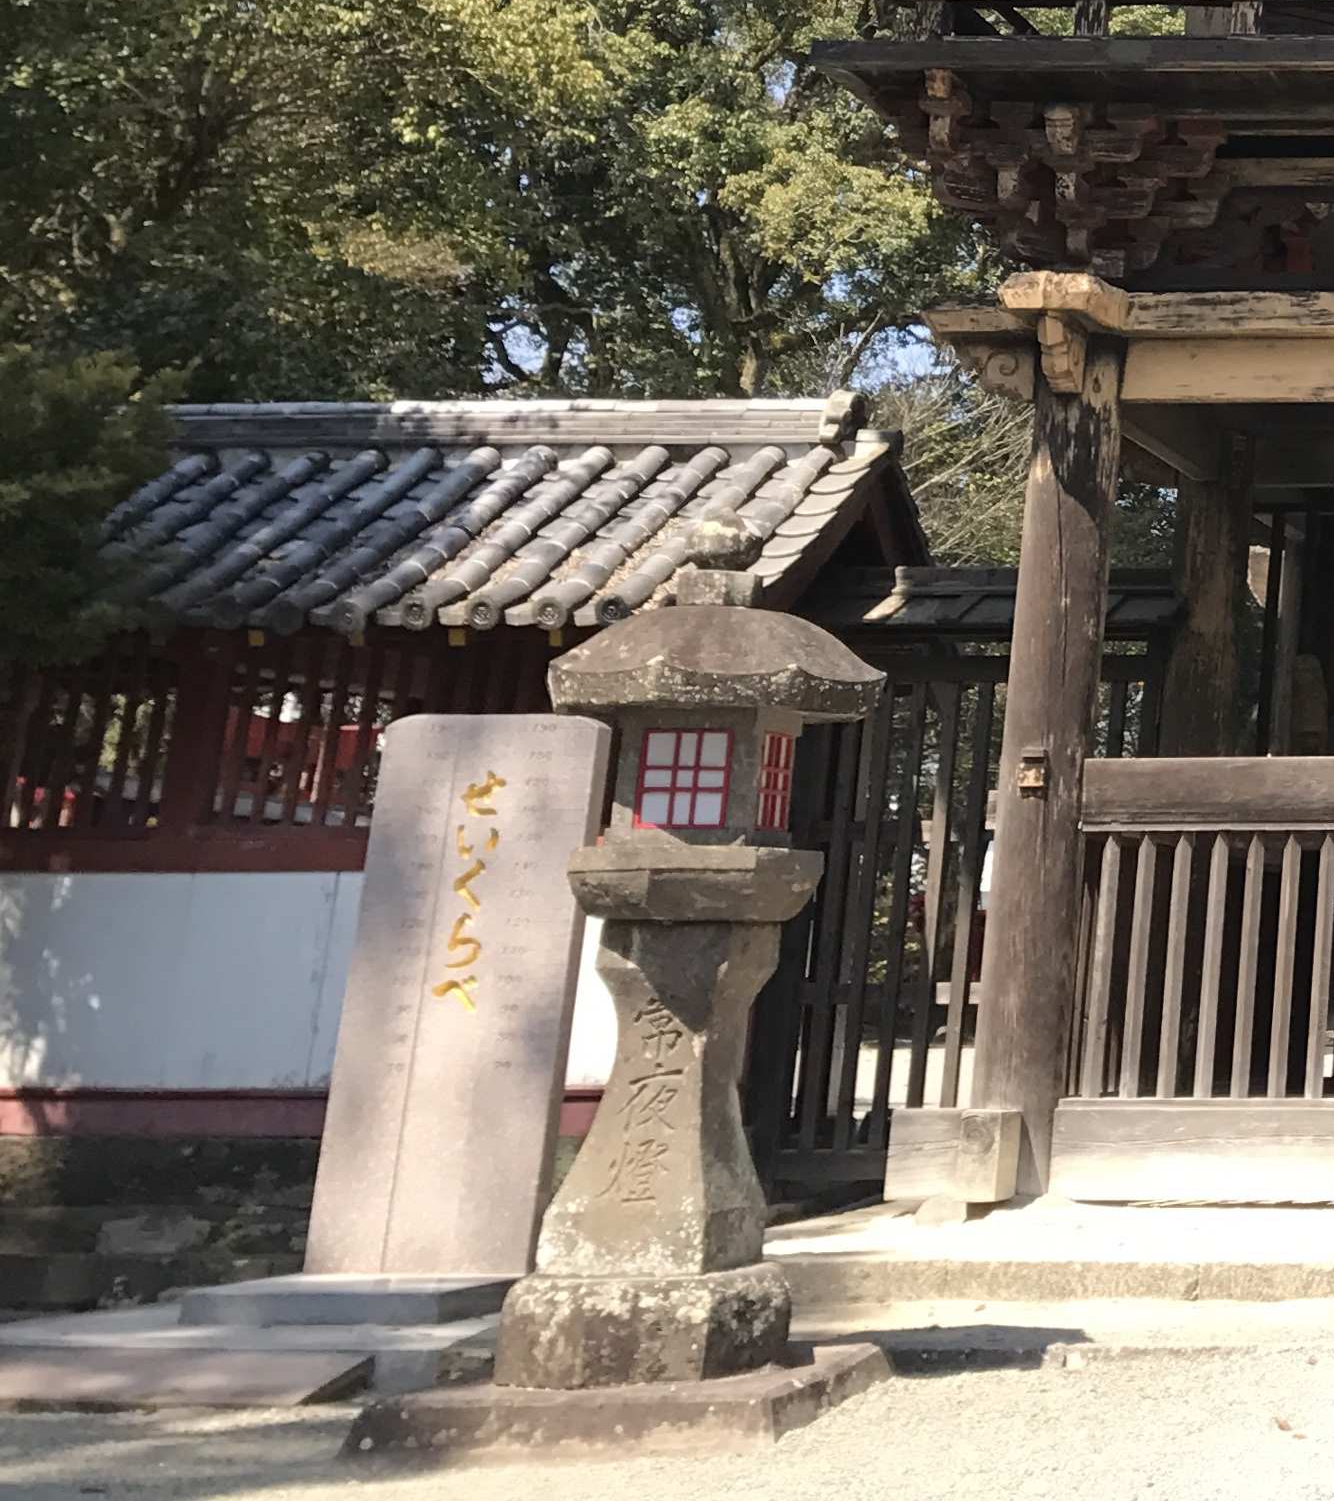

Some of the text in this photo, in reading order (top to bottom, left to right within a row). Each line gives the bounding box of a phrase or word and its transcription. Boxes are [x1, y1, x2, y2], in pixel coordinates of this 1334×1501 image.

[431, 770, 507, 1014] せいくらべ
